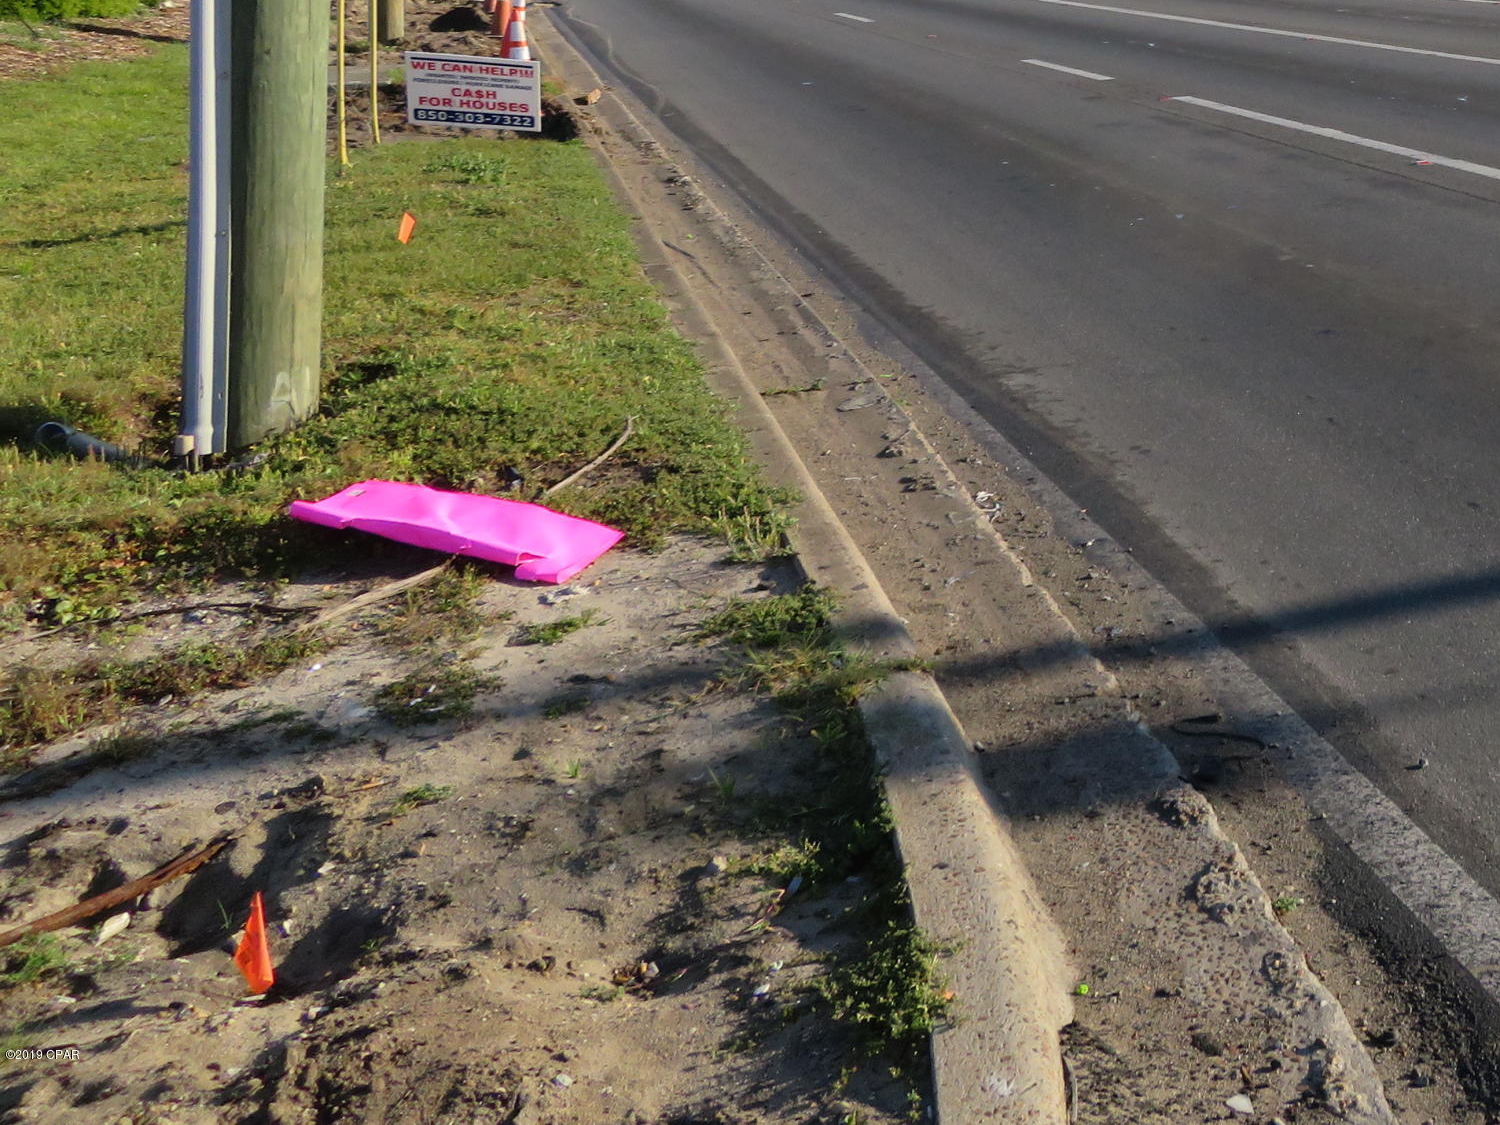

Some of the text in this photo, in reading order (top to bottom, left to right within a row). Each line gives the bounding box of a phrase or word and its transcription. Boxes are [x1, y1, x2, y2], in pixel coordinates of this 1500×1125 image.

[411, 60, 437, 71] WE
[441, 63, 473, 74] CAN
[479, 65, 534, 79] HELP!!!
[418, 96, 530, 113] FOR HOUSES
[417, 109, 533, 126] 850-303-7322
